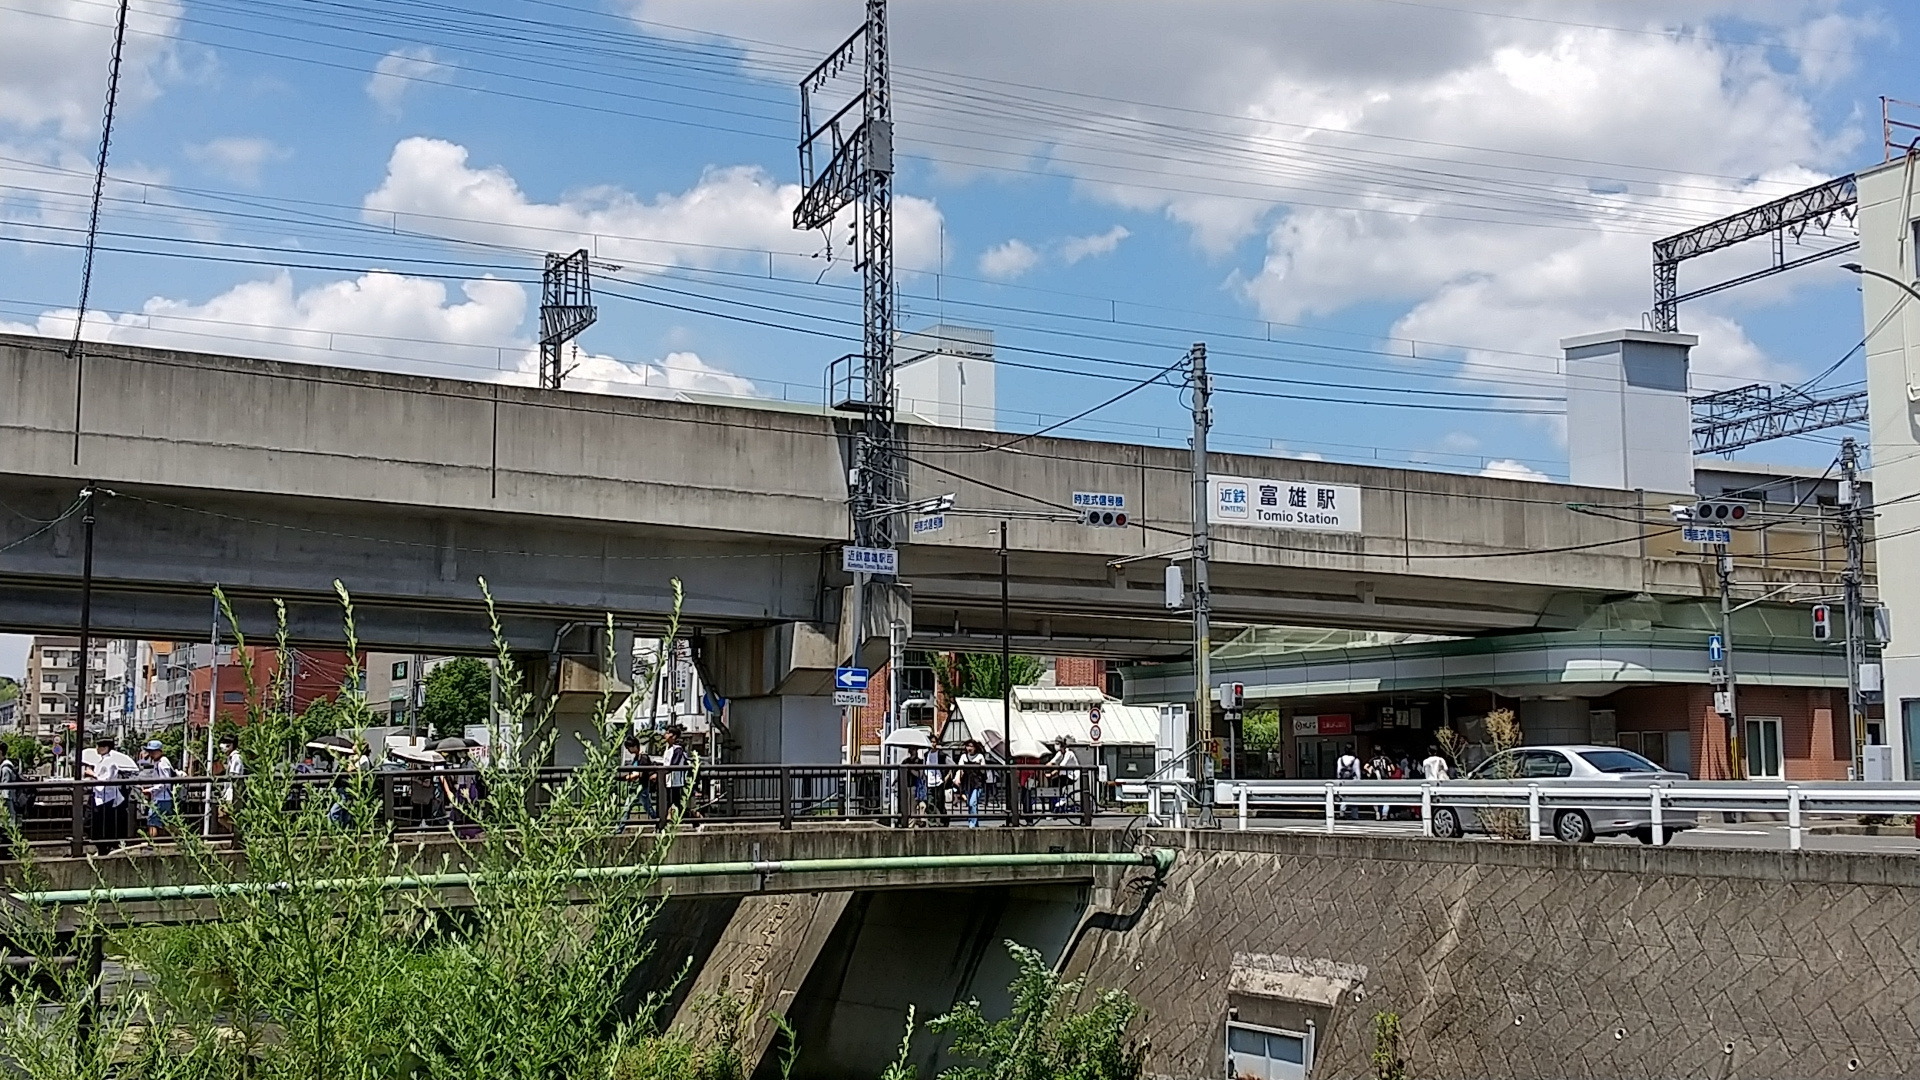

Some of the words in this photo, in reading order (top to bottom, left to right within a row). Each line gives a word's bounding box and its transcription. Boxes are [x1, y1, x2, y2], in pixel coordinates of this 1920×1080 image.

[1220, 488, 1246, 504] 近鉄
[1259, 485, 1336, 510] 富雄駅
[1221, 505, 1246, 513] KINTETSU
[1256, 509, 1293, 523] Tomio
[1297, 511, 1339, 526] Station
